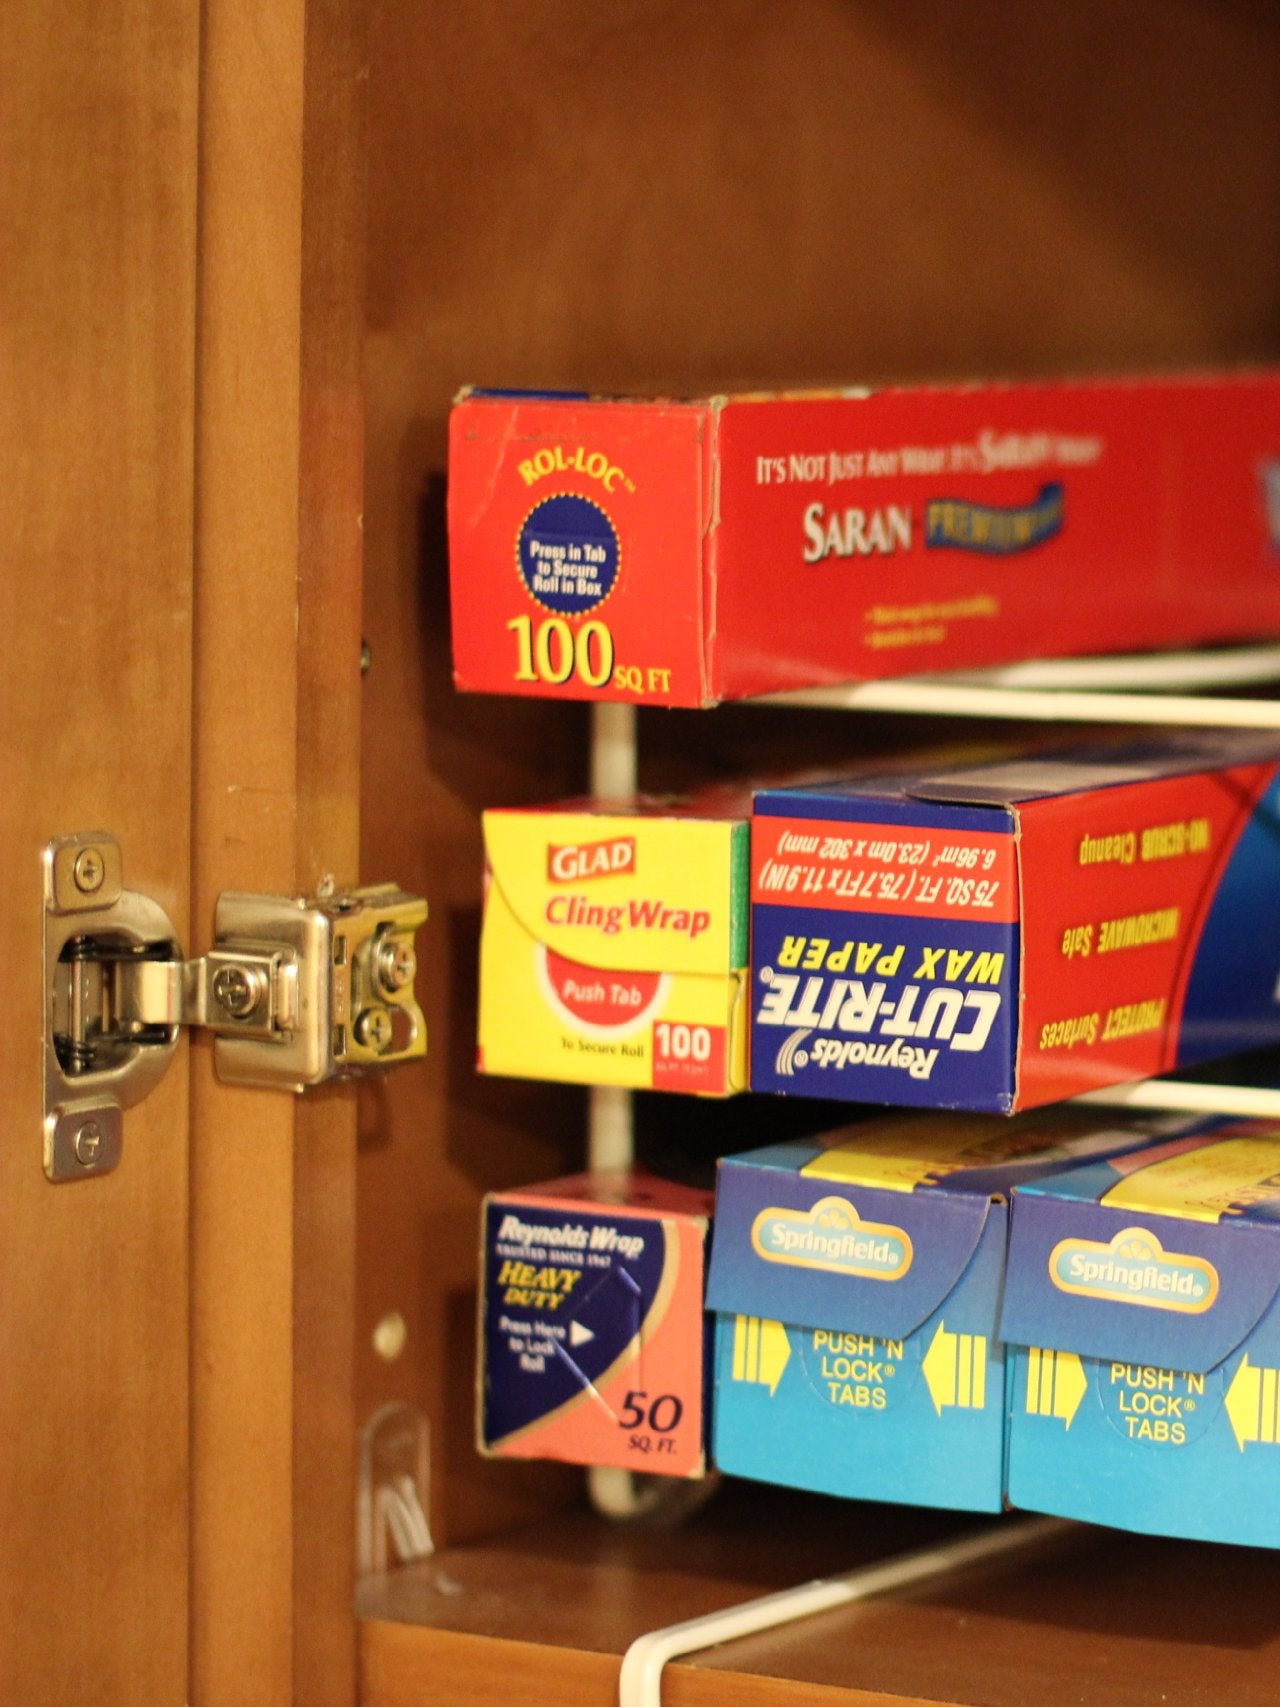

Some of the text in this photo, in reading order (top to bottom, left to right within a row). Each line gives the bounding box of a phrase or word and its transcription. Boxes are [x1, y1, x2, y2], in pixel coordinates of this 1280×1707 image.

[788, 454, 826, 483] NOT
[828, 451, 864, 486] JUST
[803, 502, 912, 563] SARAN
[530, 541, 607, 563] Press in Tab
[533, 575, 602, 597] Roll in Box
[537, 560, 598, 579] to Secure
[507, 614, 615, 688] 100
[612, 666, 672, 694] SQ FT
[552, 842, 633, 880] GLAD
[822, 836, 852, 860] 302
[1078, 832, 1137, 866] Cleanup
[1062, 922, 1093, 960] Safe
[777, 935, 1005, 985] WAX PAPER
[562, 979, 642, 1007] Push Tab
[655, 1023, 712, 1061] 100
[1039, 1014, 1099, 1050] Surfaces
[498, 1214, 645, 1260] Reynolds Wrap
[497, 1259, 582, 1293] HEAVY
[503, 1287, 565, 1311] DUTY
[812, 1329, 874, 1357] PUSH
[1110, 1362, 1174, 1392] PUSH
[617, 1389, 684, 1433] 50
[826, 1381, 888, 1410] TABS
[1124, 1415, 1187, 1445] TABS
